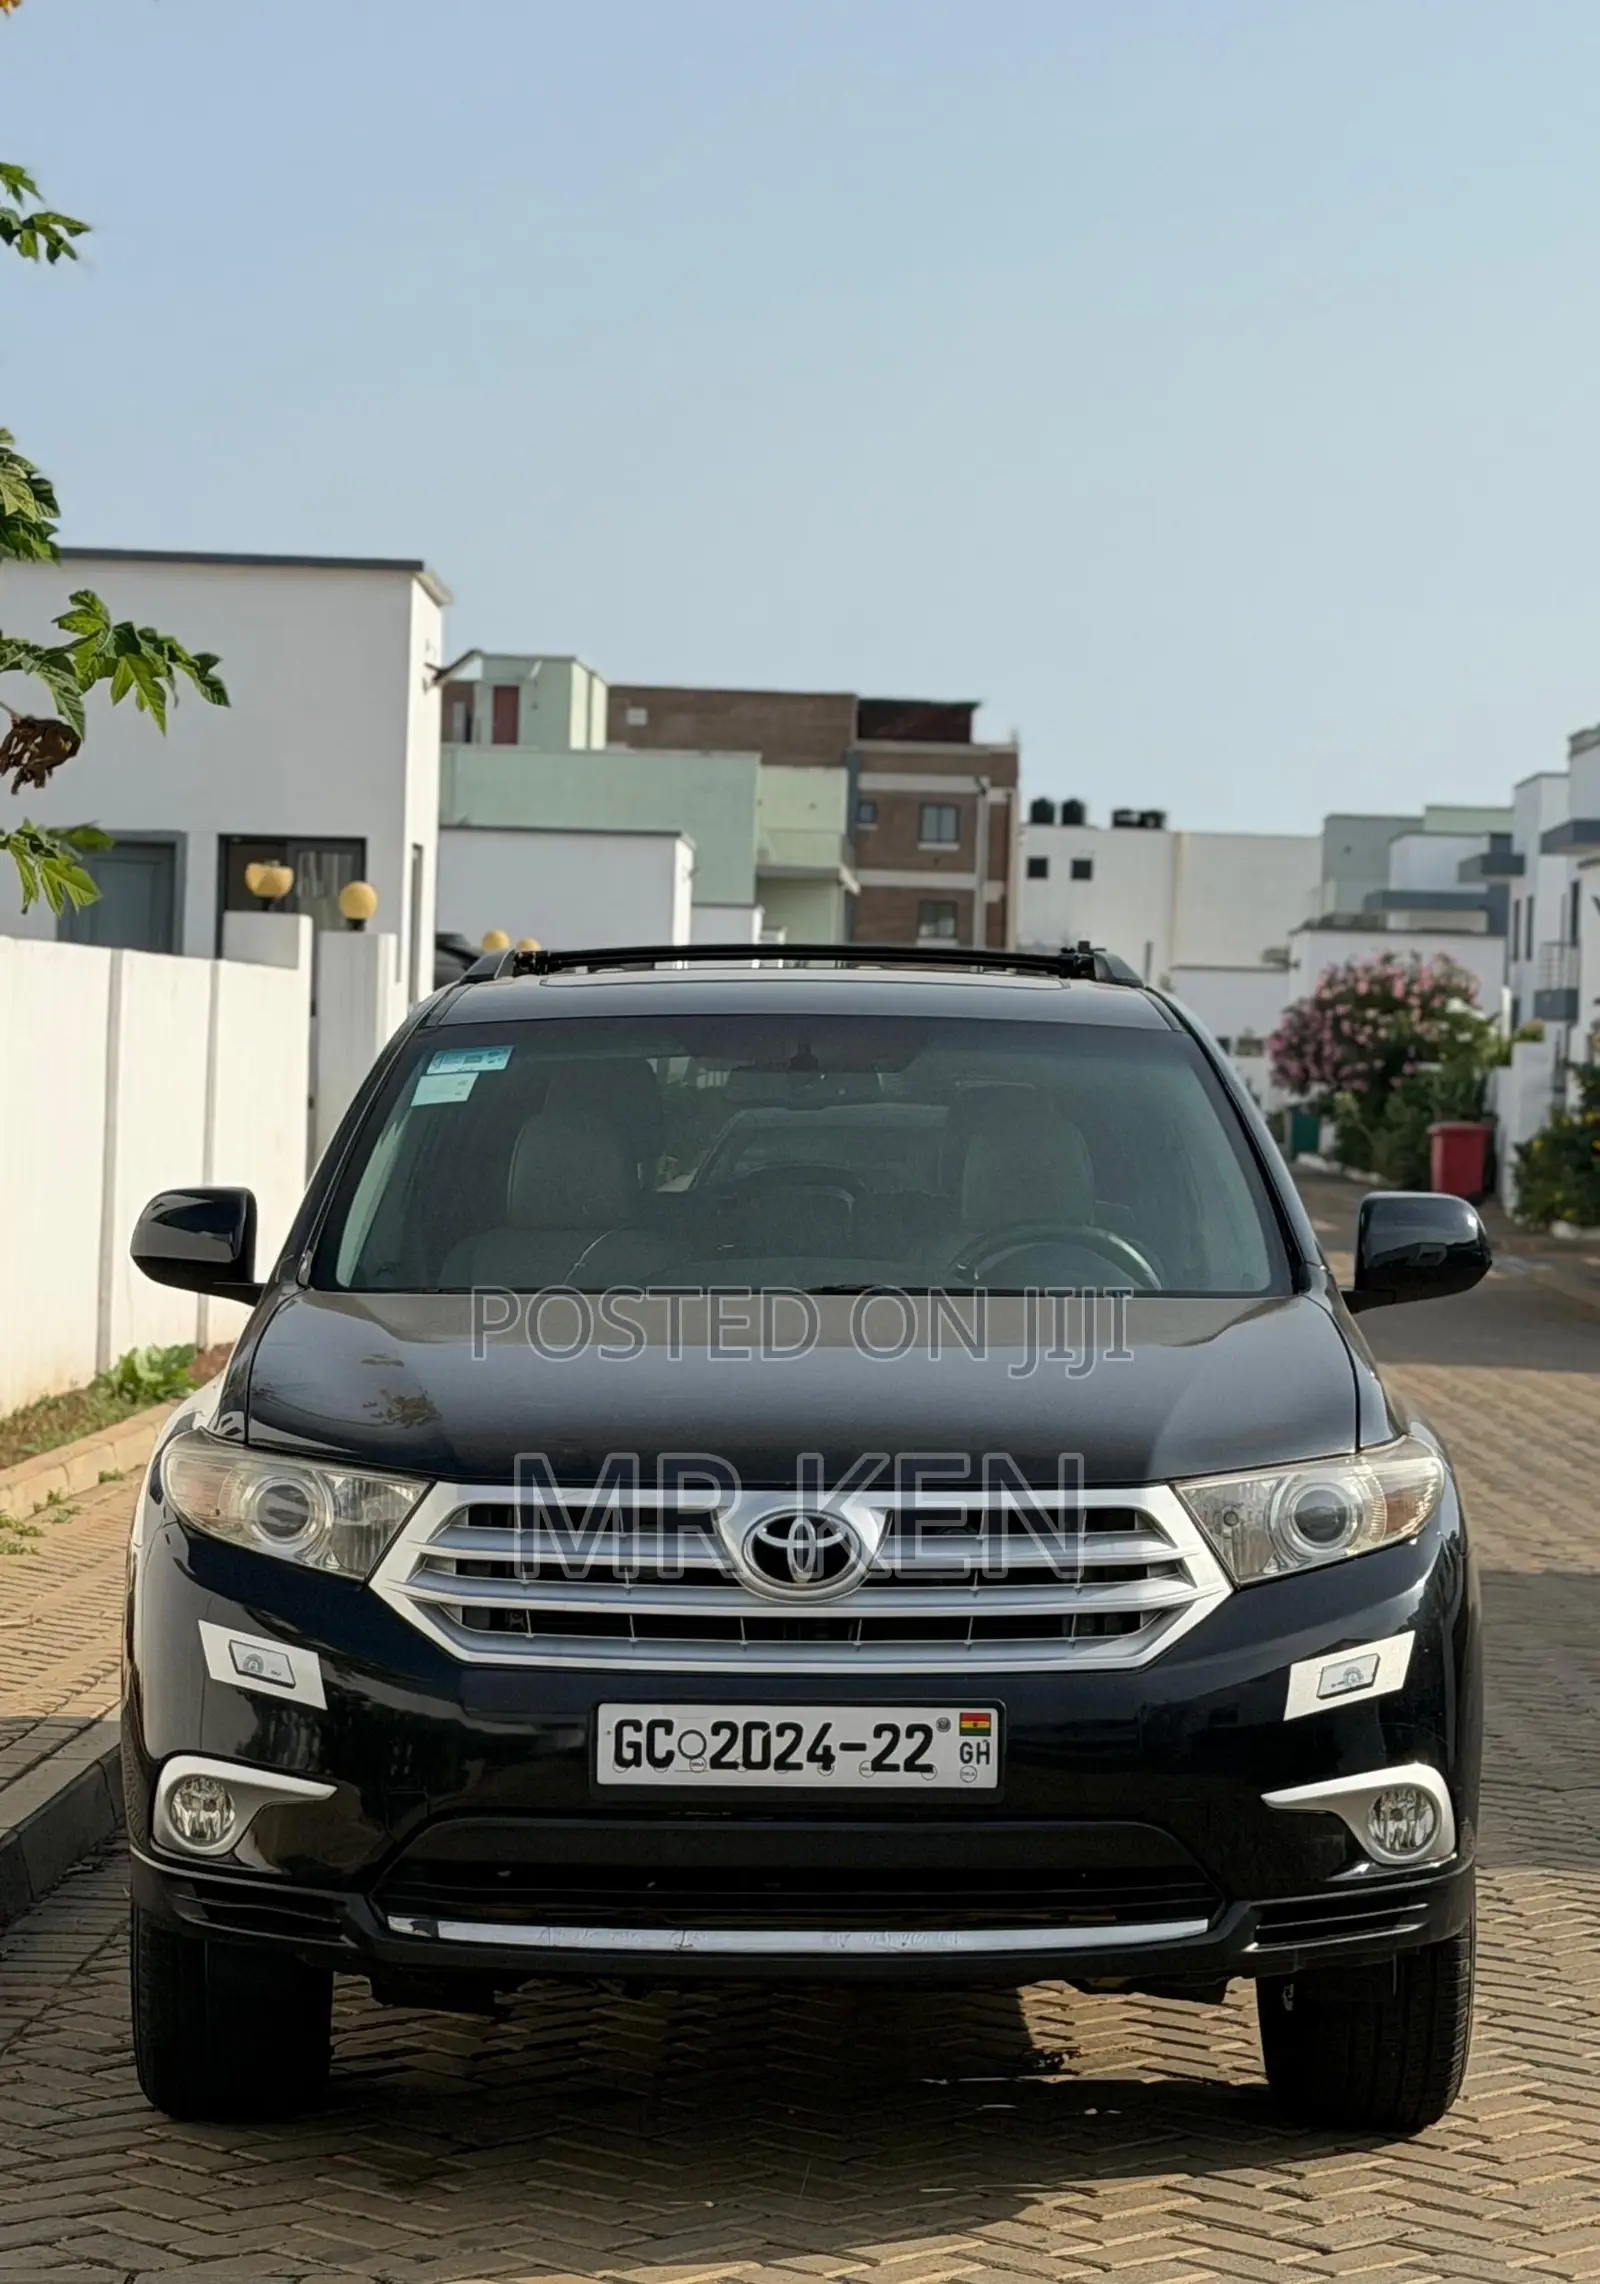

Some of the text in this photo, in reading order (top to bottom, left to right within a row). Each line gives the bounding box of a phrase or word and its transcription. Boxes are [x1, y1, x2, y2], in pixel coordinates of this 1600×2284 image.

[613, 1718, 934, 1773] GC 2024-22
[959, 1740, 991, 1765] GH
